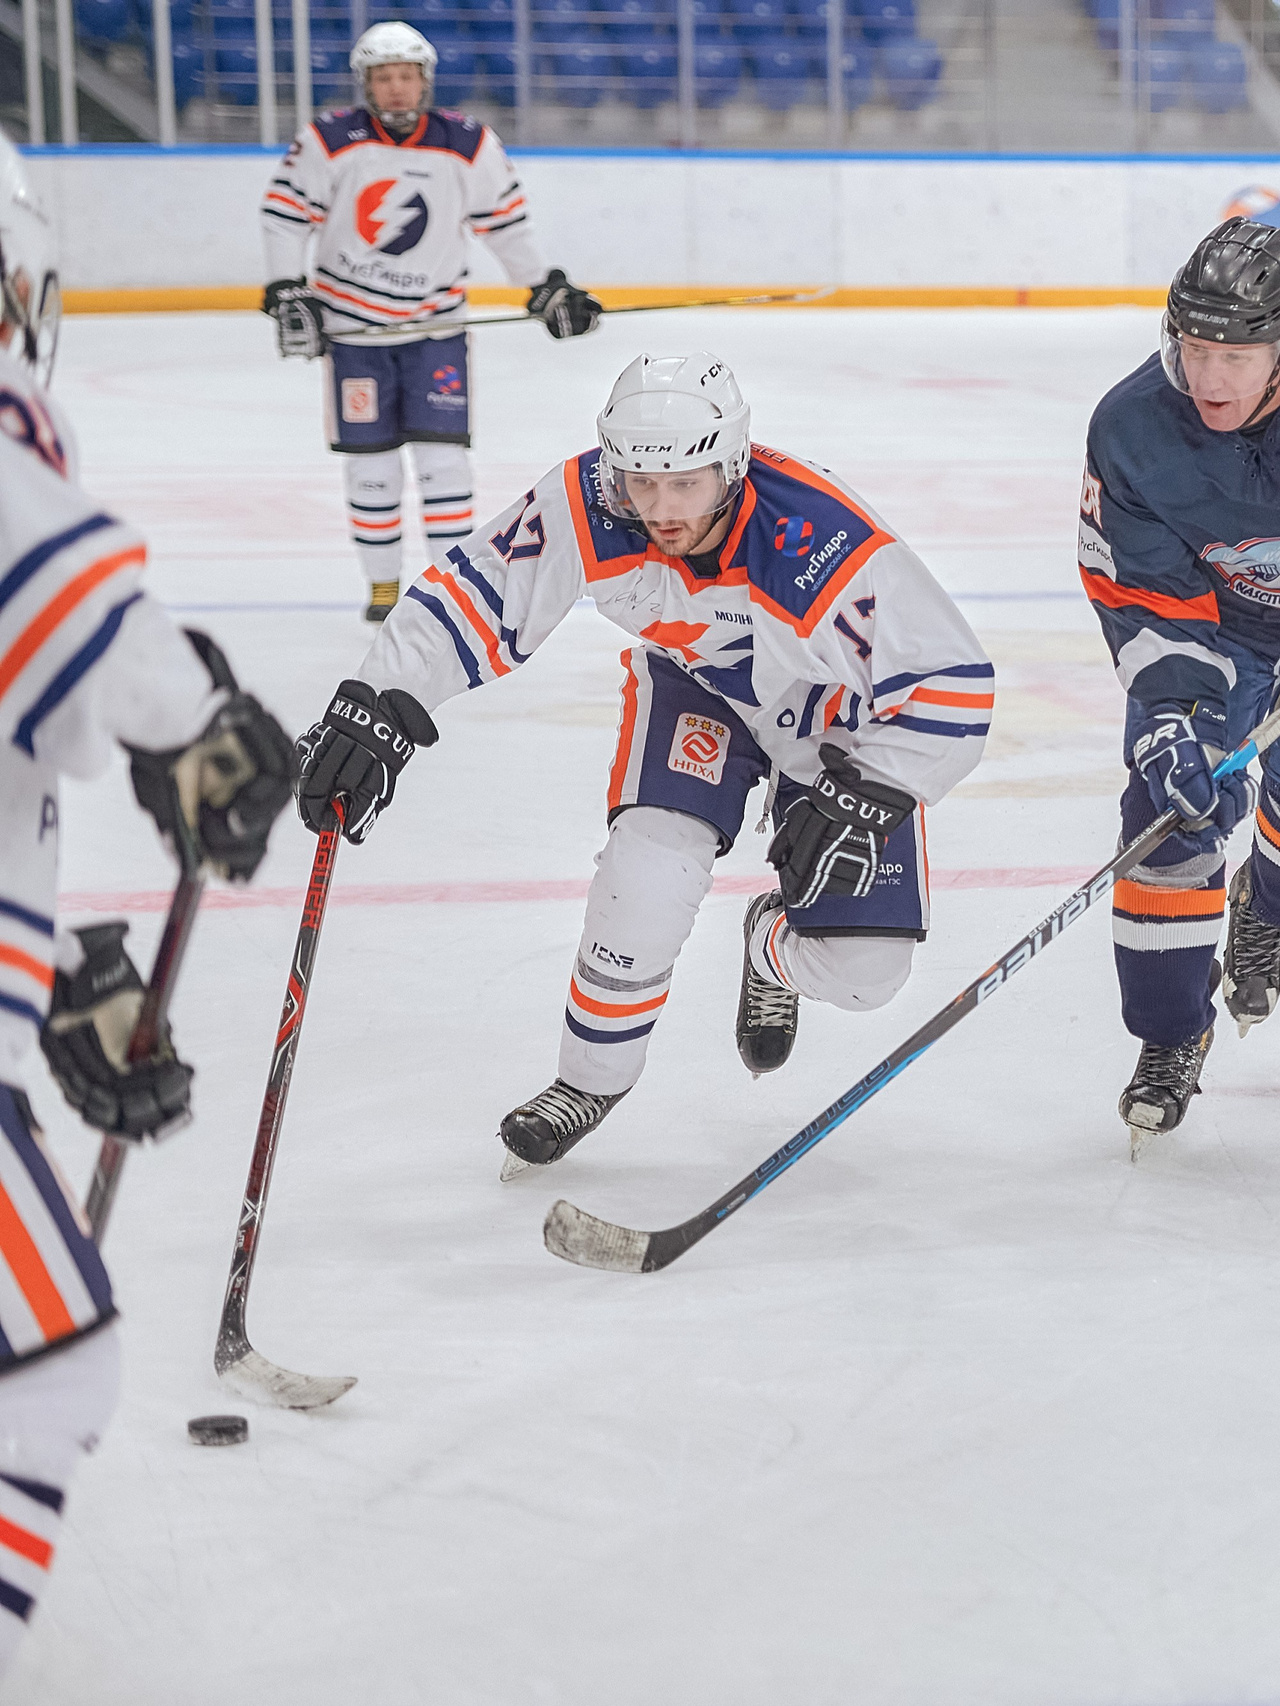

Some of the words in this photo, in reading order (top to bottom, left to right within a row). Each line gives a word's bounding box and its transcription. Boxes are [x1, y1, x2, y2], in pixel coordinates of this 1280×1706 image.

[631, 445, 673, 454] CCM
[488, 487, 548, 566] 17
[794, 530, 848, 590] РусГидро
[331, 699, 371, 726] MAD
[372, 722, 414, 761] GUY
[674, 758, 716, 781] НПХЛ
[837, 794, 893, 825] GUY
[300, 829, 338, 930] BAUER
